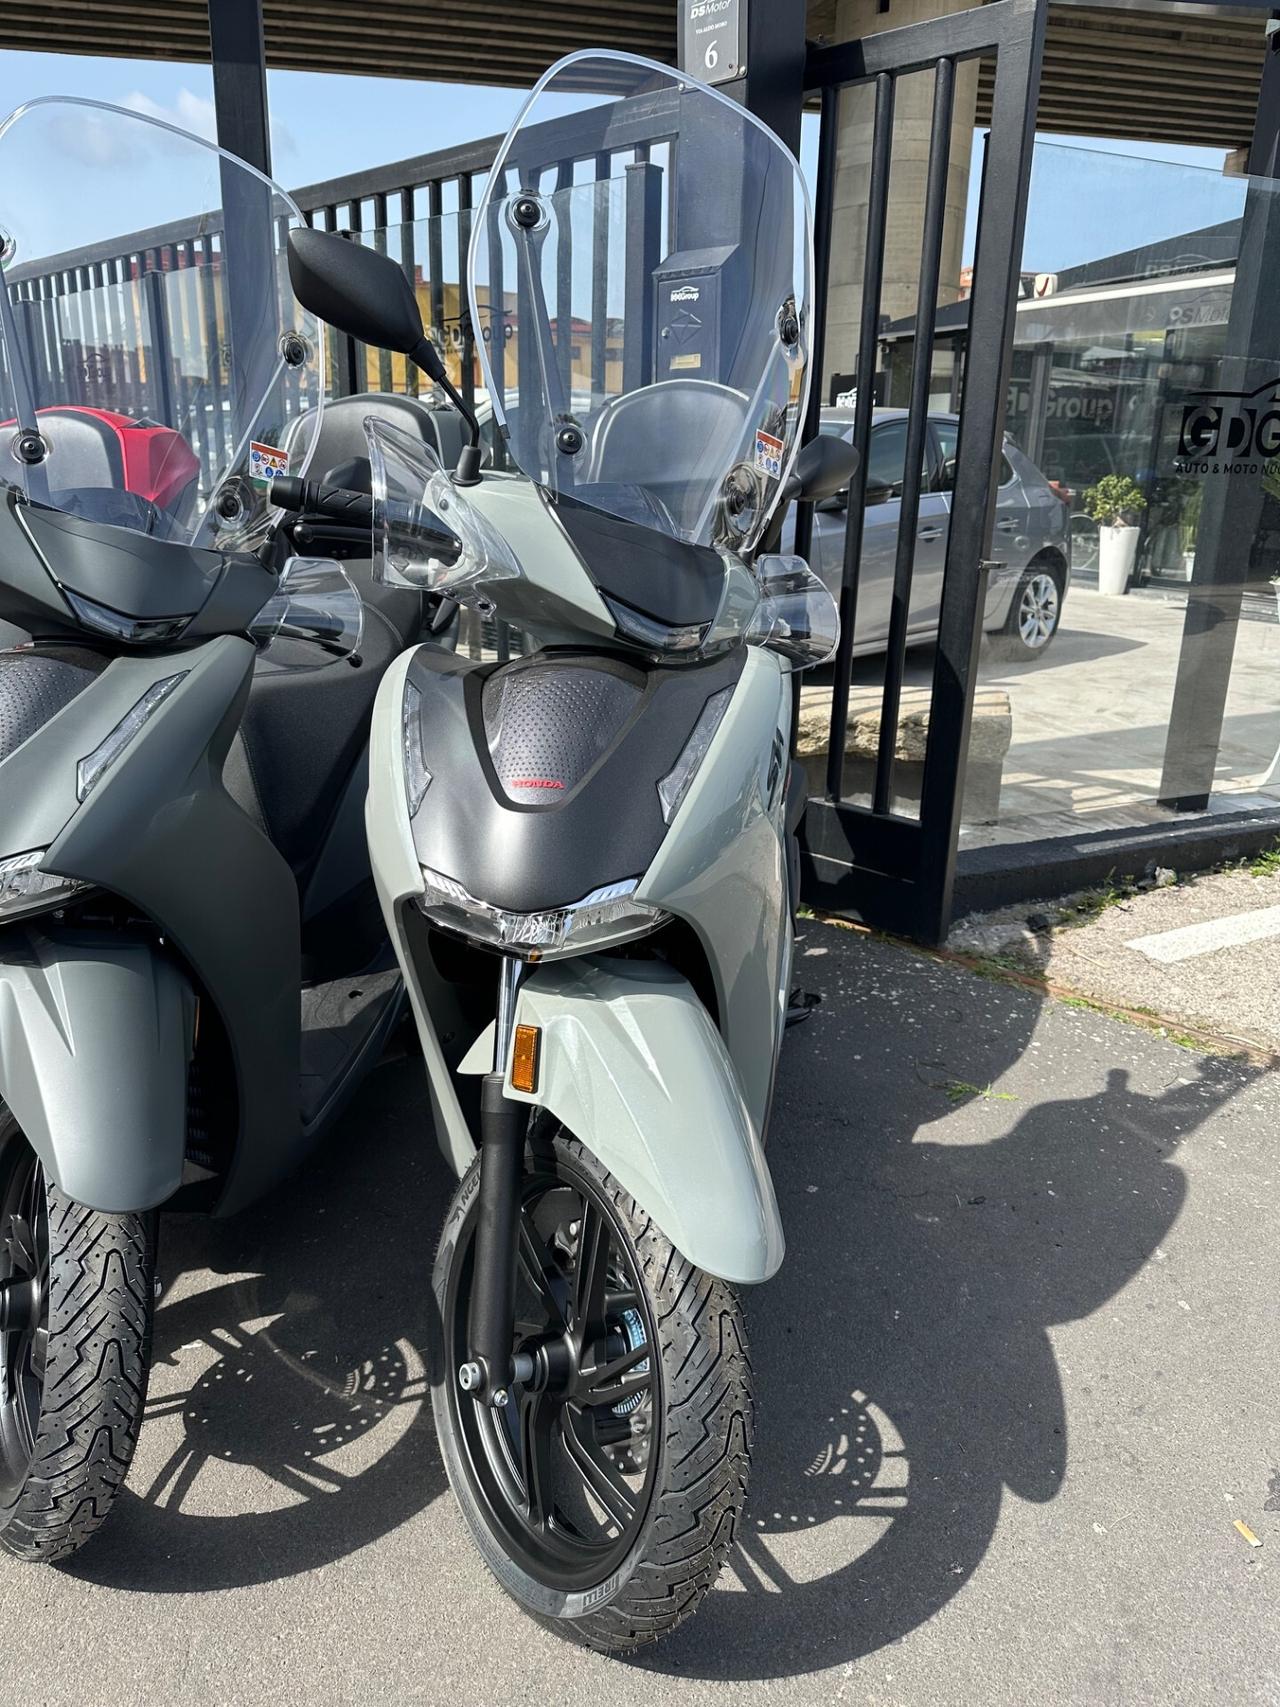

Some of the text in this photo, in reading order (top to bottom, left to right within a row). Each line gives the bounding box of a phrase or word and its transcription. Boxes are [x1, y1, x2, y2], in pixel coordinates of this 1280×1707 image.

[690, 0, 731, 19] DSMotor
[704, 40, 719, 69] 6
[1175, 463, 1209, 475] AUTO
[1212, 463, 1220, 474] &
[1223, 463, 1258, 475] MOTO
[511, 779, 565, 789] HONDA
[582, 1573, 622, 1613] PIRELLI
